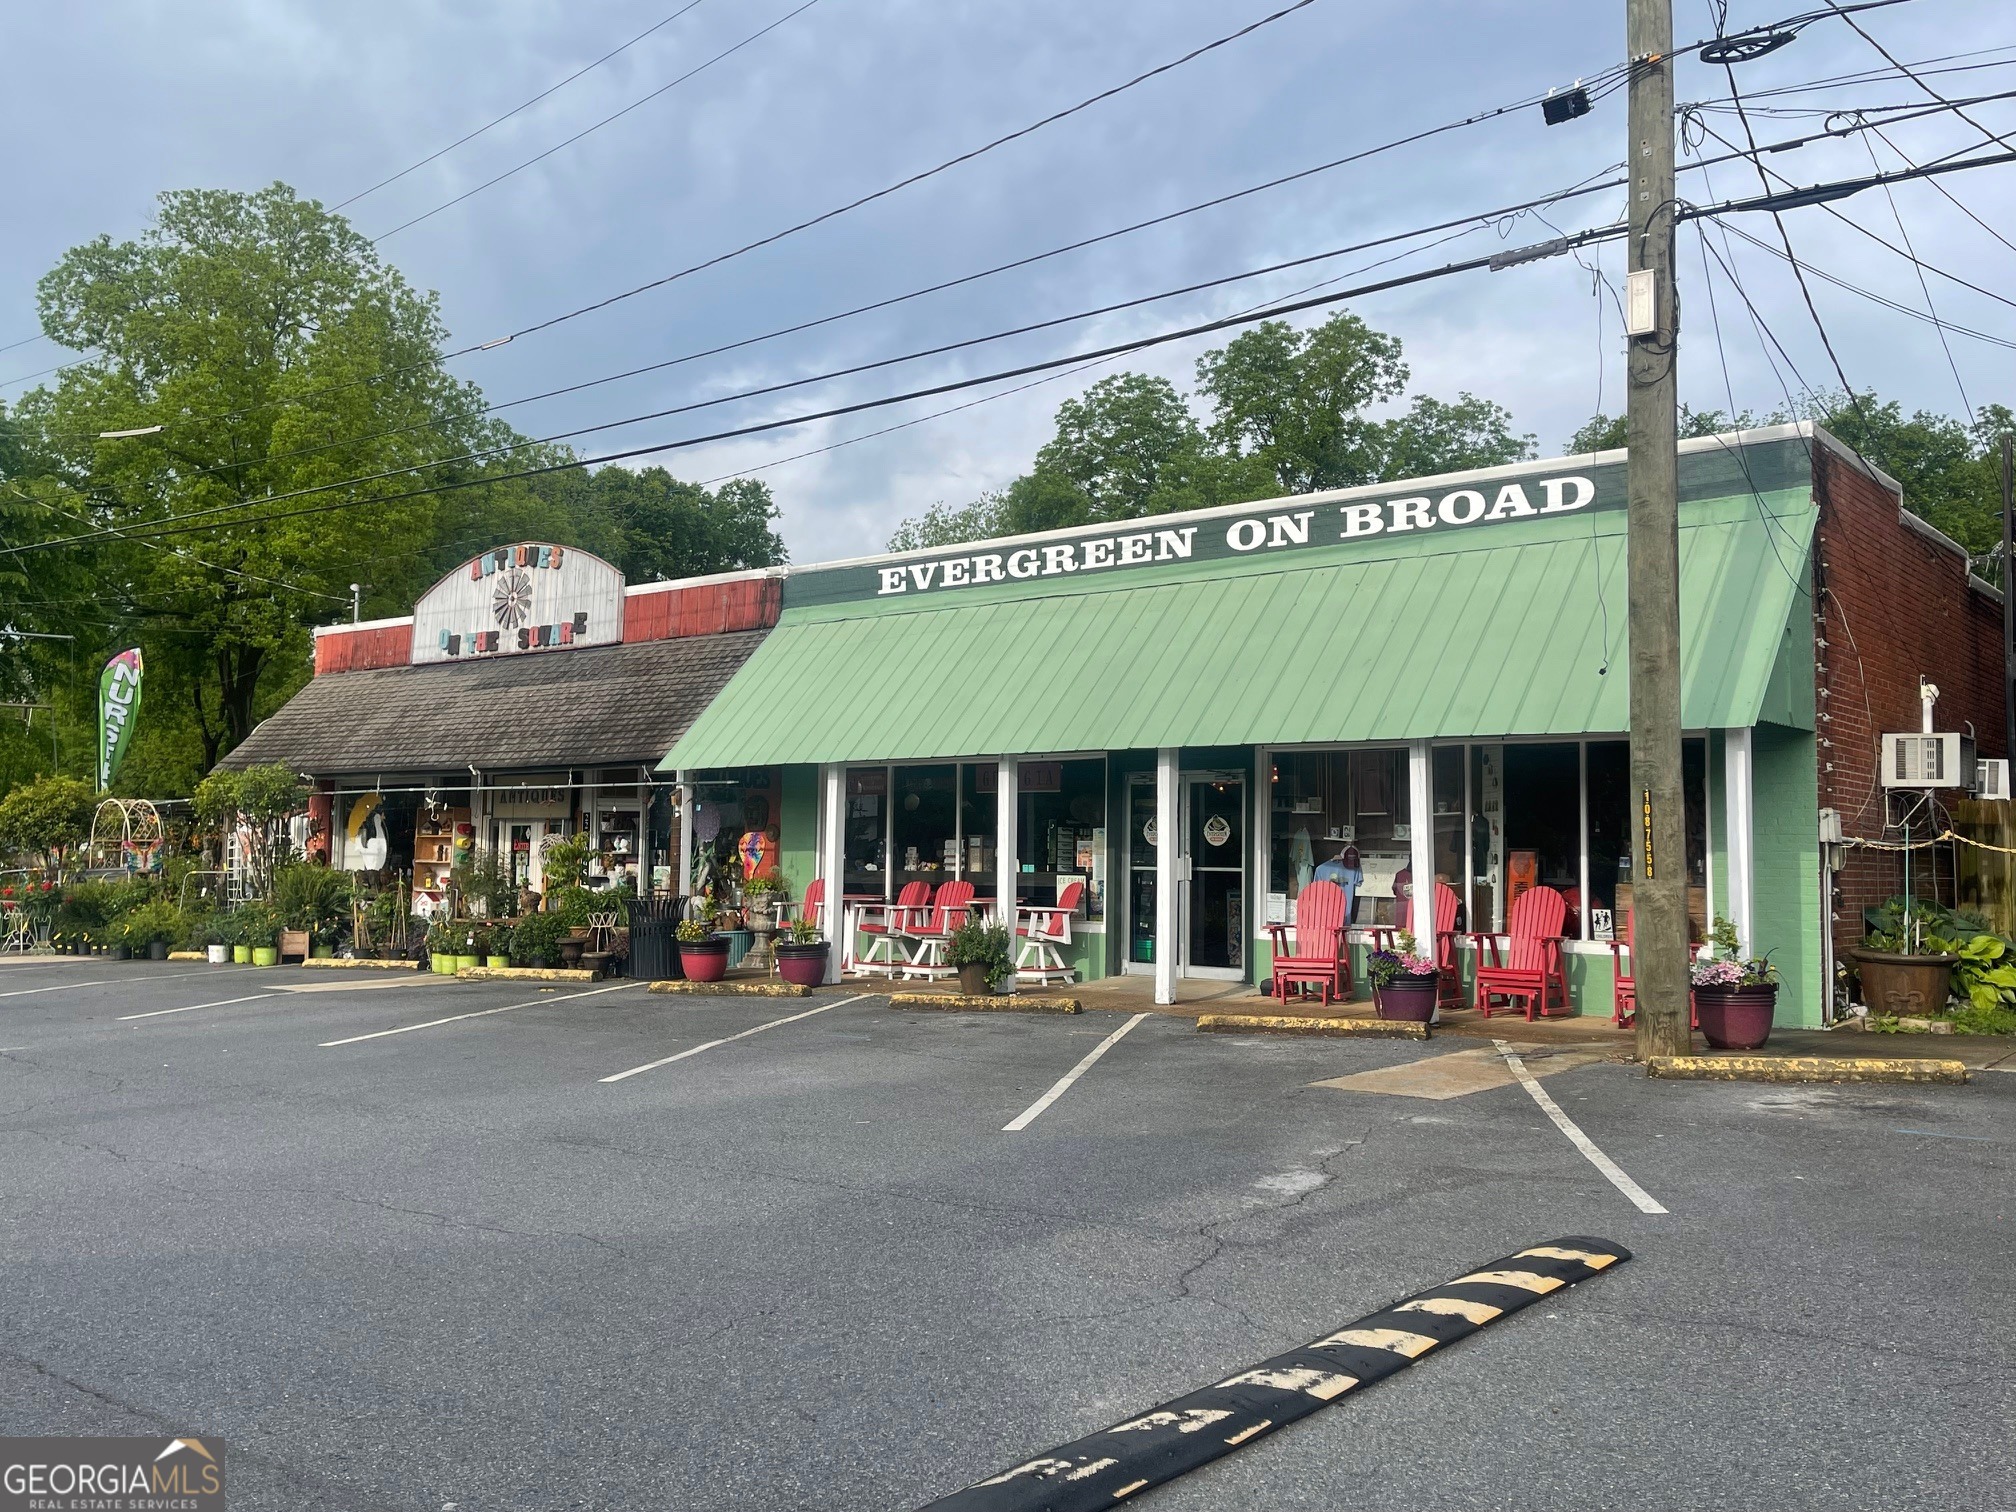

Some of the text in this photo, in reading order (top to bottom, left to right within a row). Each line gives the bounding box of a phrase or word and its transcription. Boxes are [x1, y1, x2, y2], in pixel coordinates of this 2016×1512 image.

[877, 475, 1597, 596] EVERGREEN ON BROAD
[470, 545, 564, 581] ANTIQUES
[438, 612, 587, 655] ON THE SQUARE
[101, 662, 140, 790] NURS
[499, 788, 565, 804] ANTIQUES
[1643, 791, 1653, 877] 1087558
[1058, 877, 1066, 886] ICE
